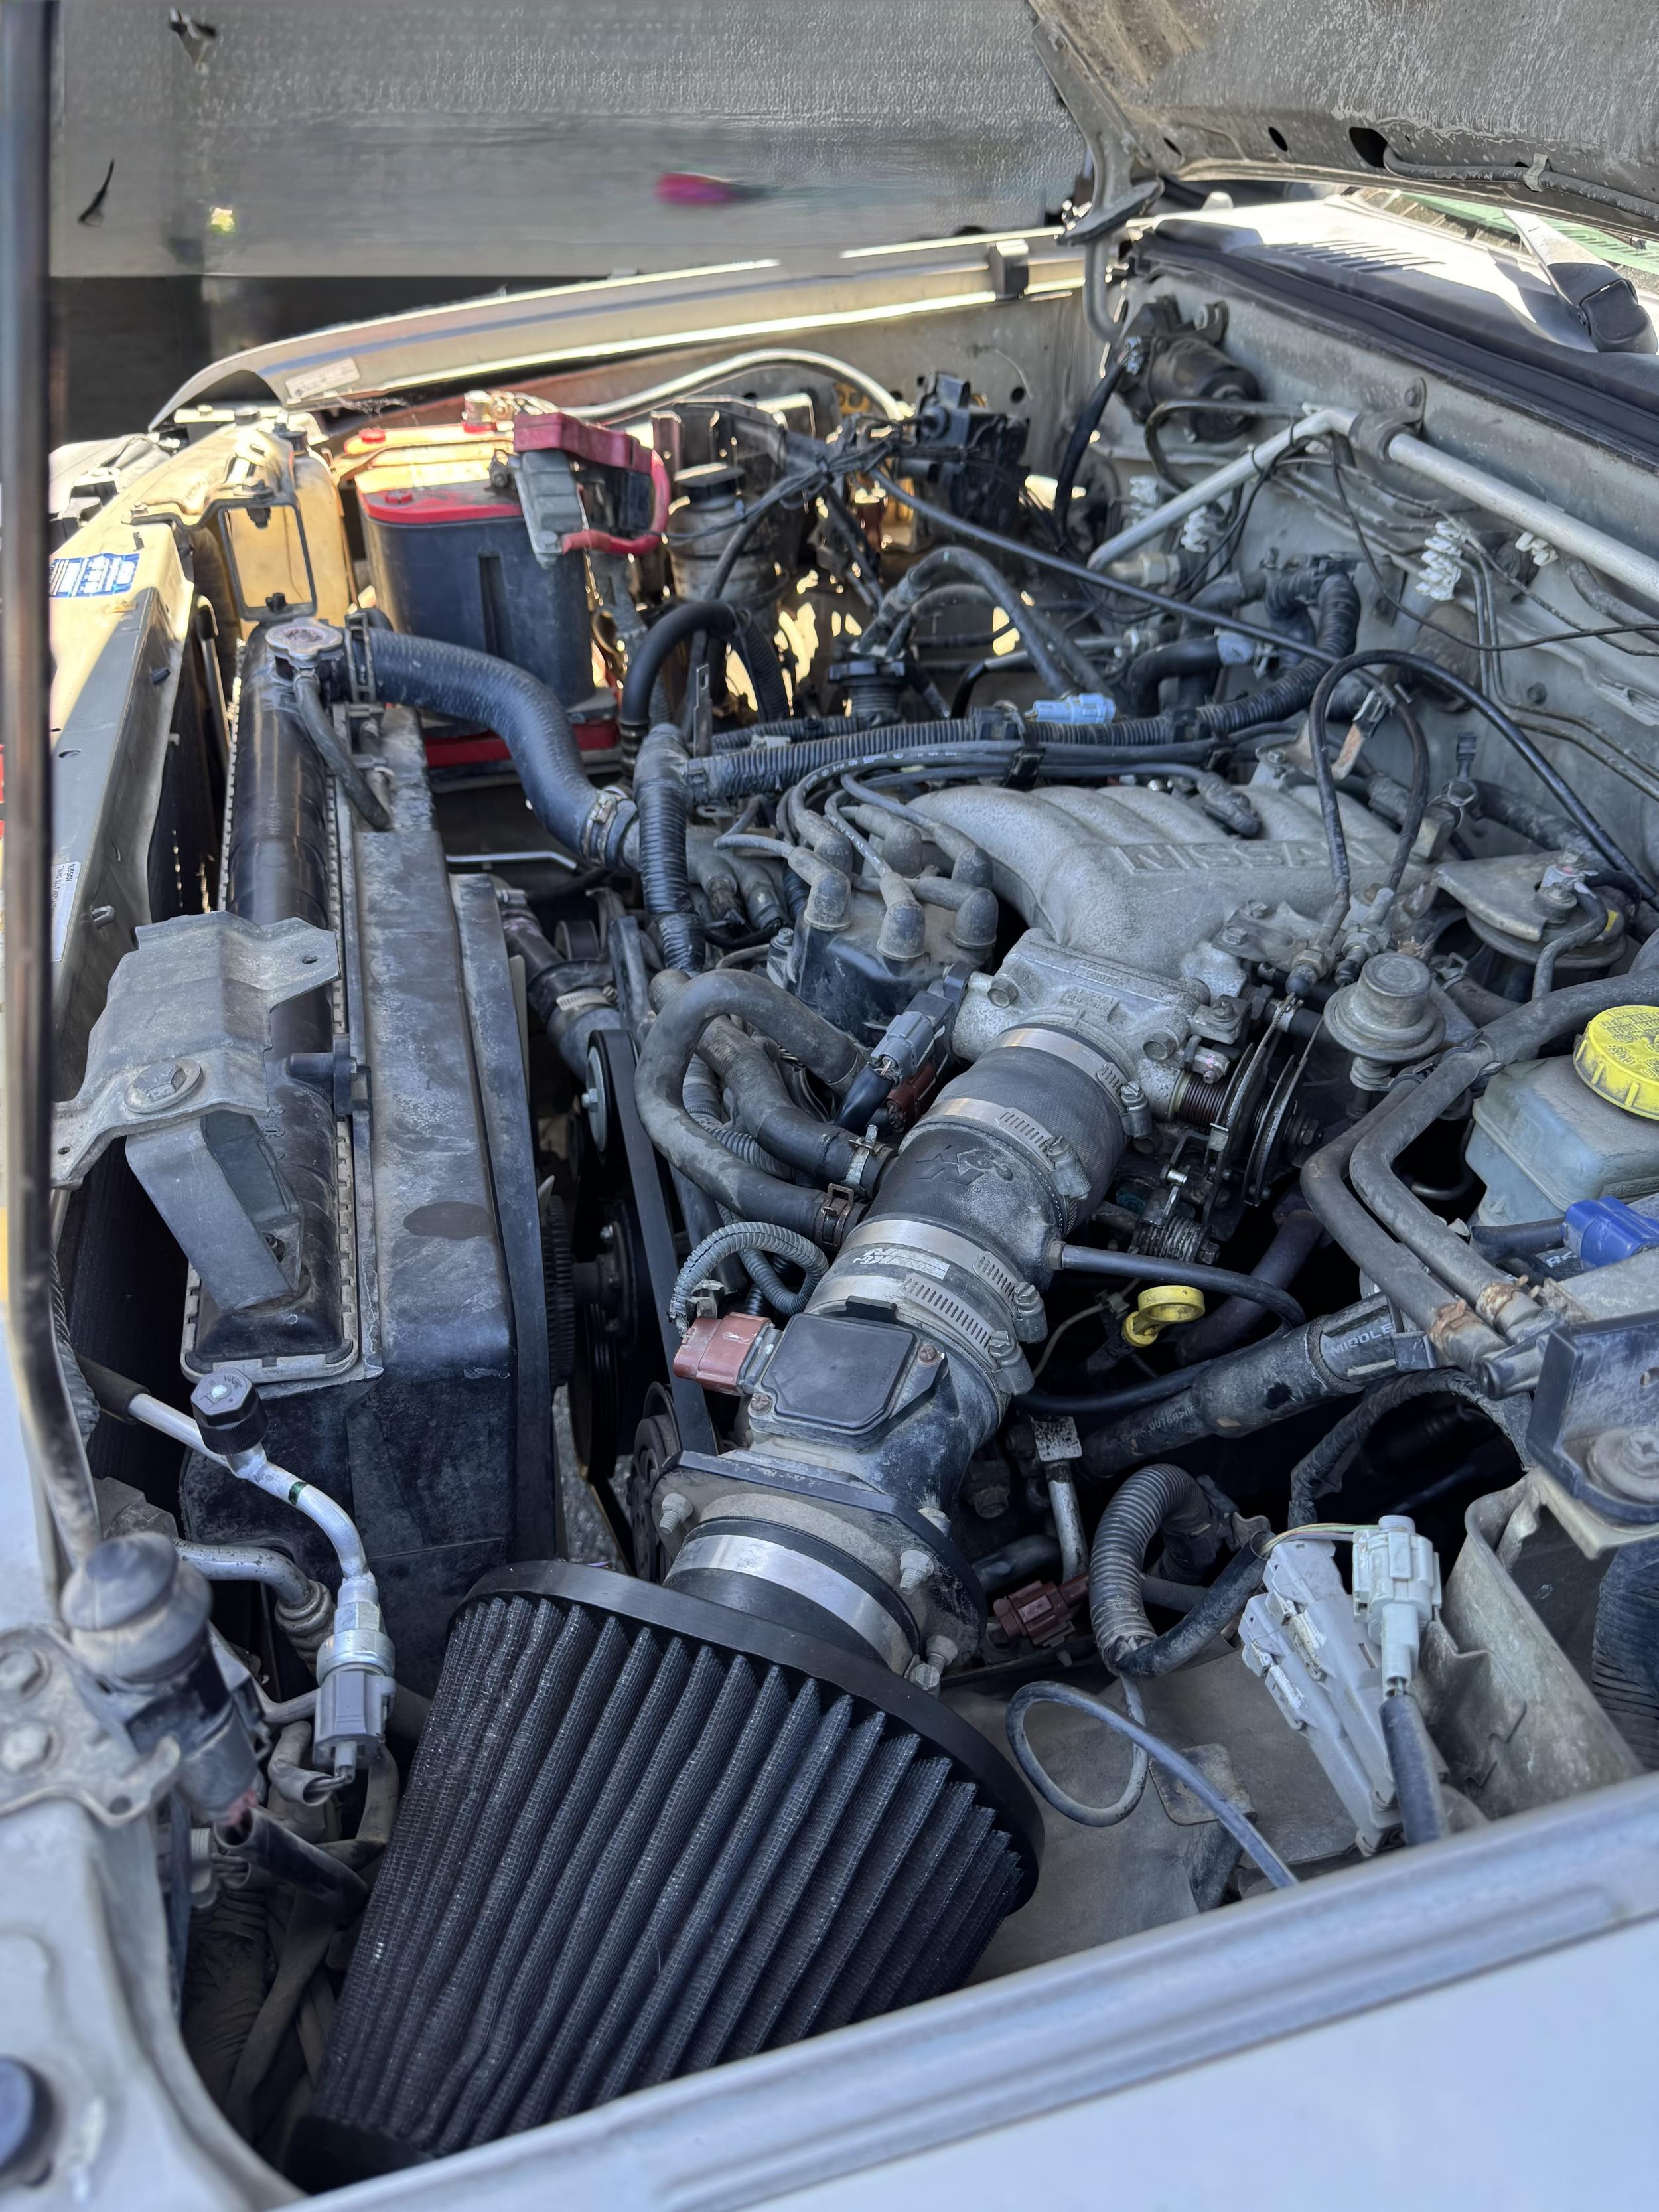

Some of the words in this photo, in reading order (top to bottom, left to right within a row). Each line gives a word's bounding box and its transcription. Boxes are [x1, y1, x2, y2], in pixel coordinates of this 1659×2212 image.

[64, 863, 76, 882] NISSAN
[1111, 840, 1387, 874] NISSAN
[875, 1360, 897, 1396] HITACHI
